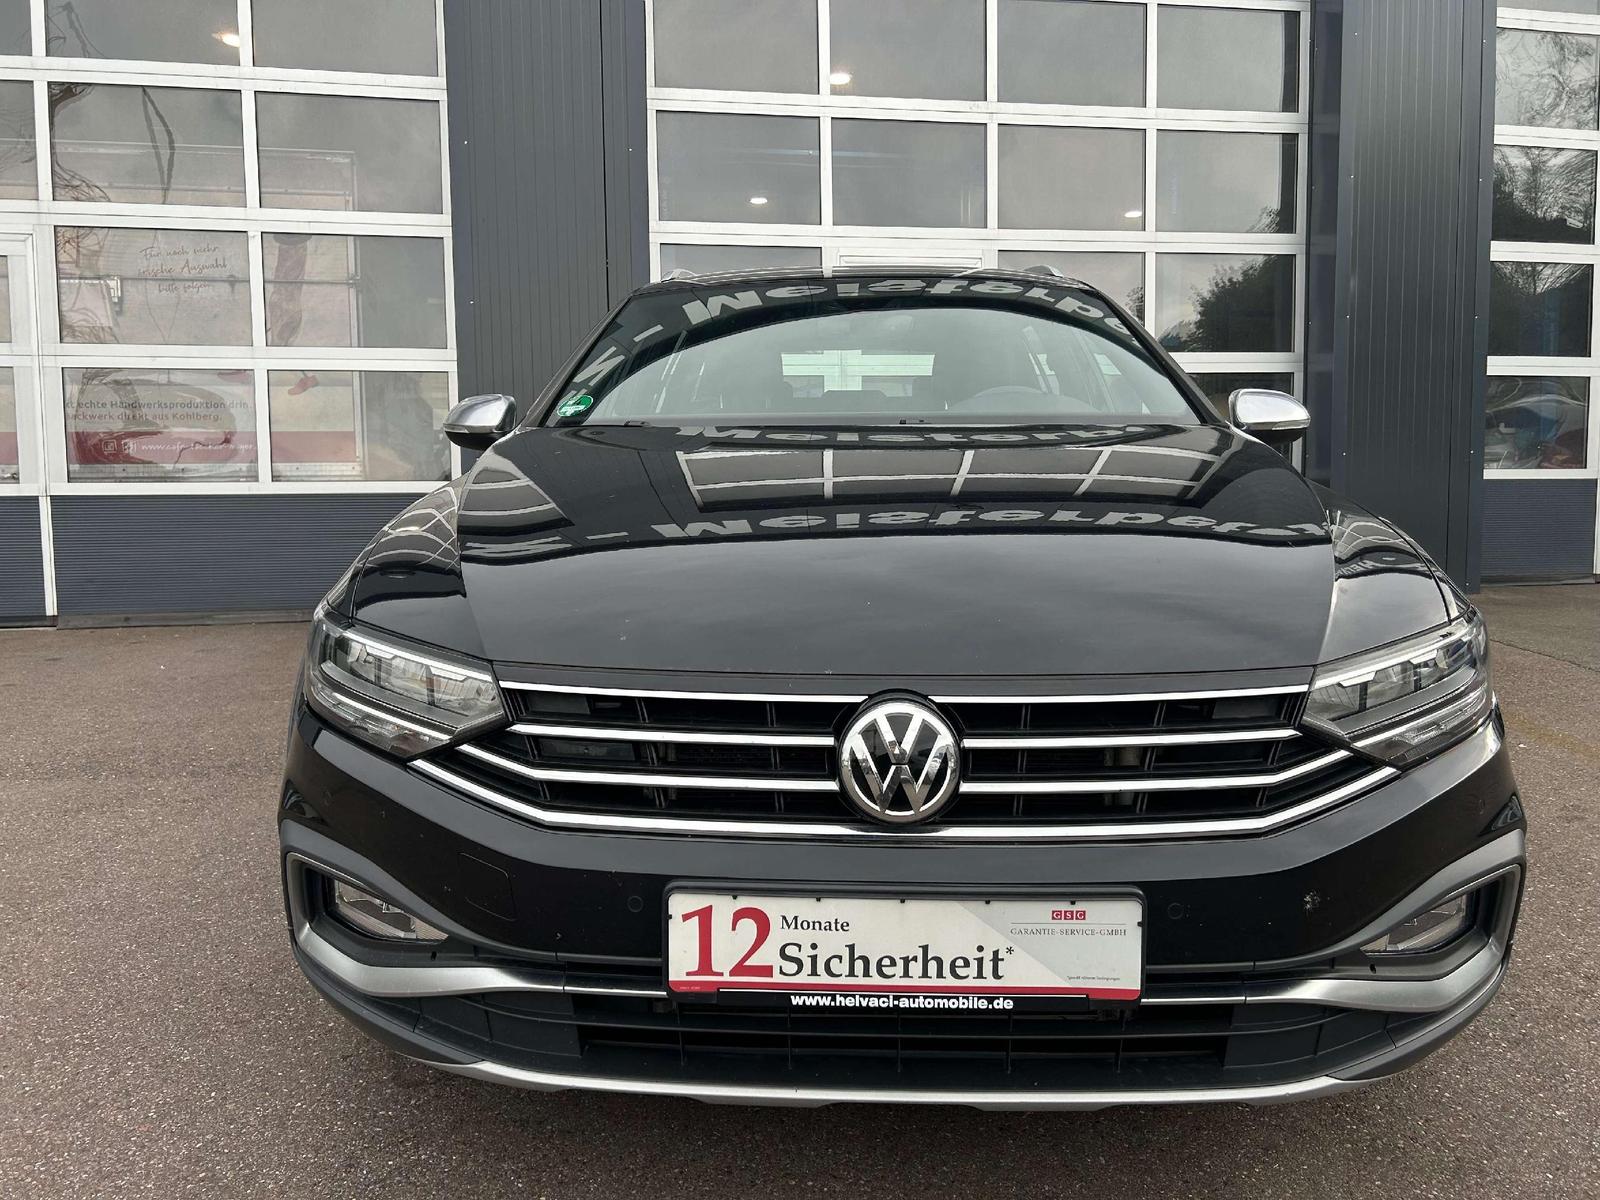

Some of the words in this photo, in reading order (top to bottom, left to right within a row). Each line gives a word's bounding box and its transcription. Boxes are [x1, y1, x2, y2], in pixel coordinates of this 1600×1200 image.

[79, 399, 108, 409] echte
[110, 399, 226, 411] Handwerksproduktion
[117, 411, 148, 421] direkt
[151, 413, 169, 422] aus
[172, 411, 223, 424] Kohlberg.
[1052, 910, 1086, 921] GSG
[780, 914, 850, 932] Monate
[681, 904, 773, 978] 12
[790, 995, 1014, 1010] www.helvaci-automobile.de
